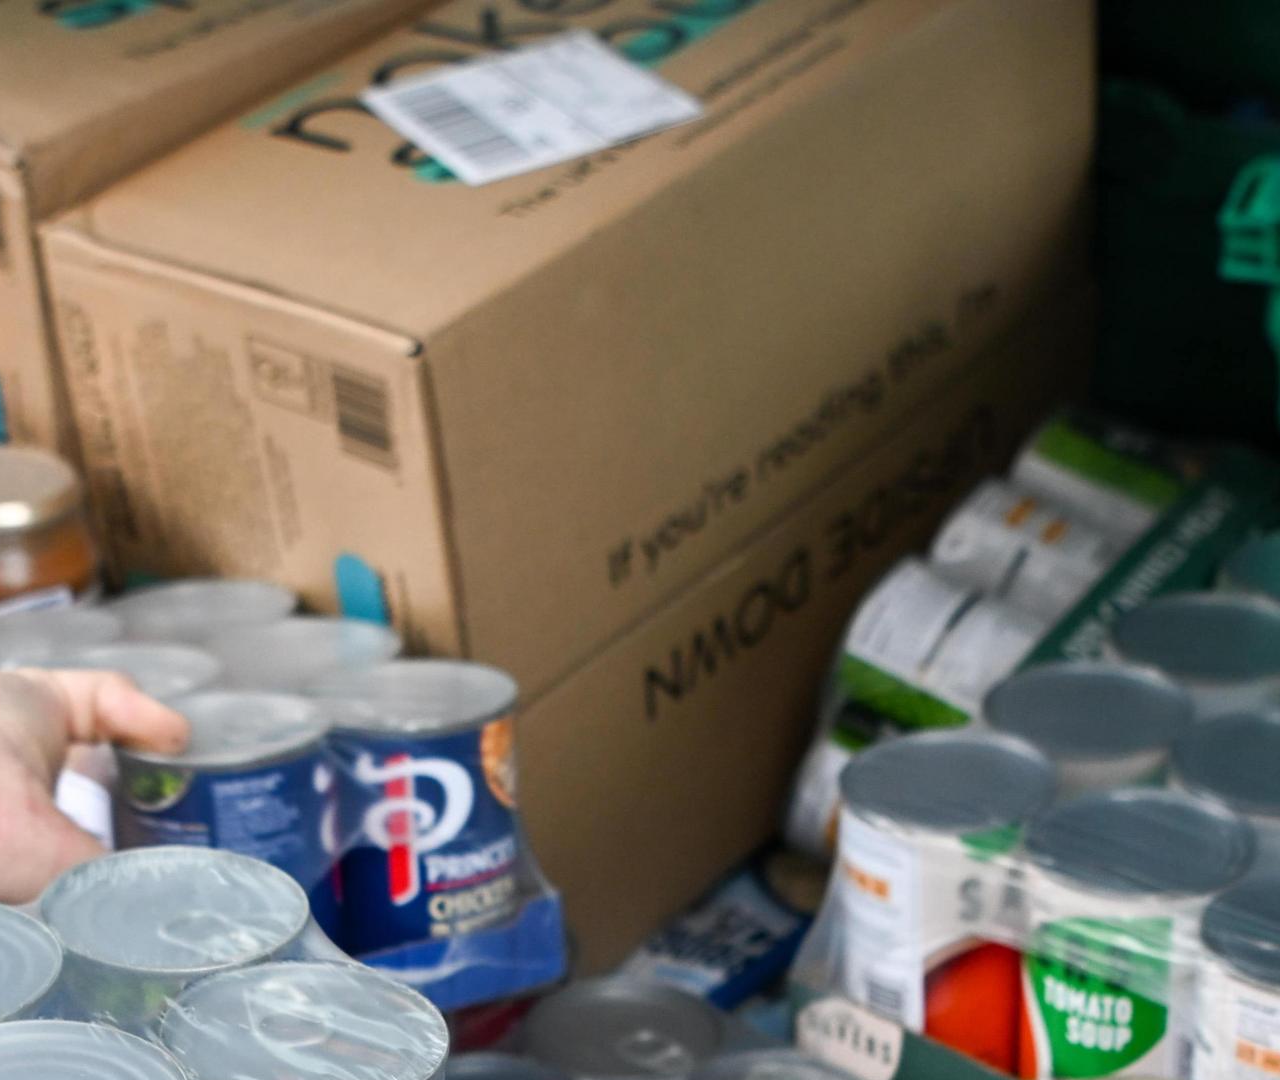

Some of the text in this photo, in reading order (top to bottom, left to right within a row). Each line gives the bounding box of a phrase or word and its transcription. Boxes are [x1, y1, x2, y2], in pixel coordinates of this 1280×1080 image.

[644, 549, 809, 719] DOWN
[1042, 974, 1133, 1026] TOMATO
[1065, 1014, 1133, 1053] SOUP
